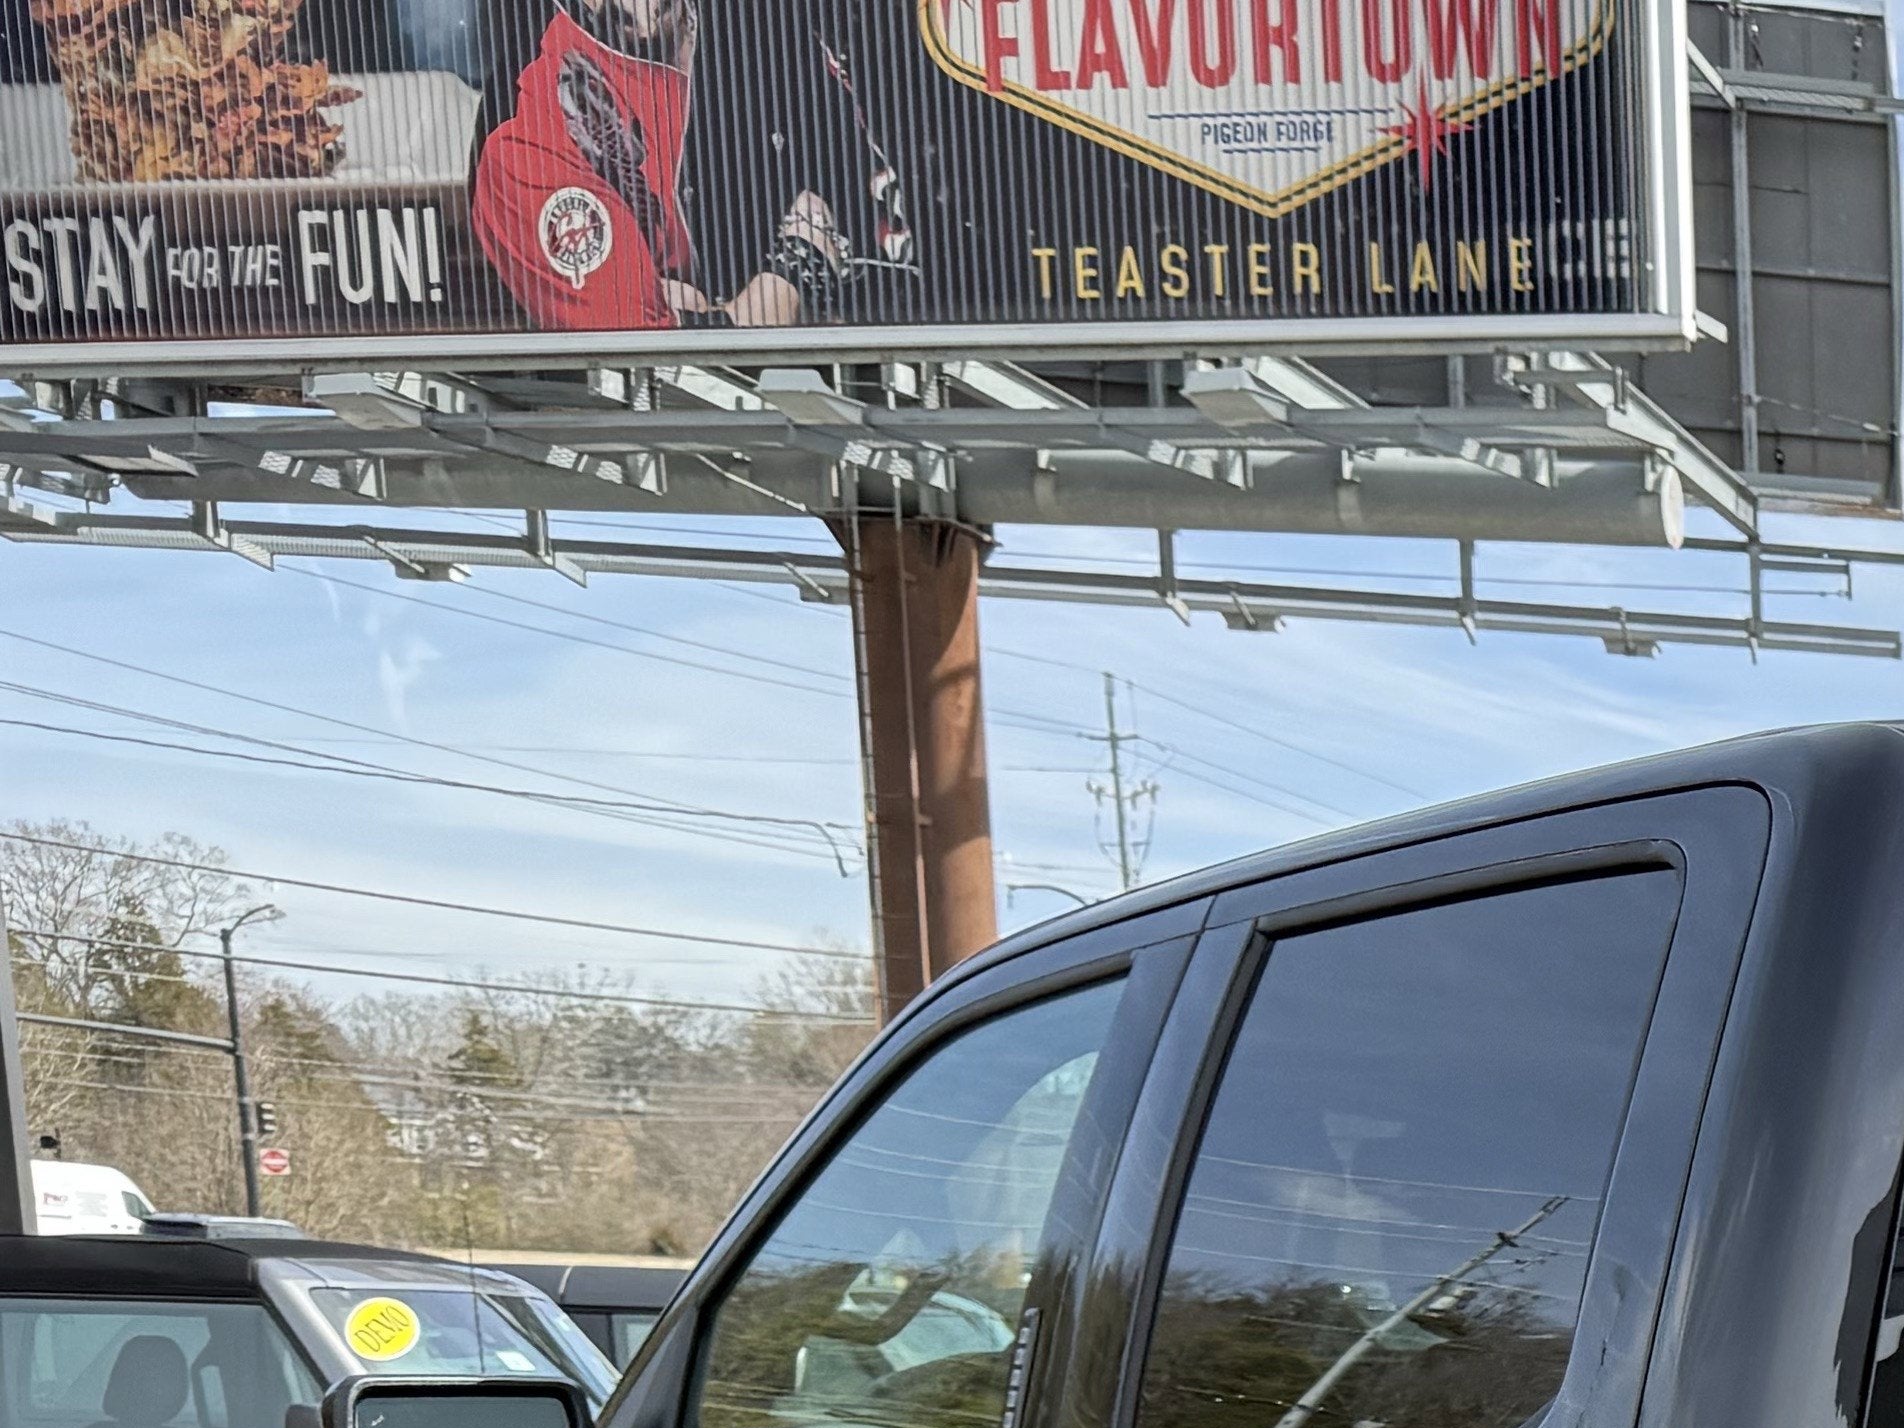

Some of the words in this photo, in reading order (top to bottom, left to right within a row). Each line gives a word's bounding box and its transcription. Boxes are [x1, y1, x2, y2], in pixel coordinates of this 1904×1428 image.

[1200, 121, 1270, 147] PIGEON
[1275, 120, 1336, 145] FORGE
[4, 213, 156, 313] STAY
[166, 246, 219, 289] FOR
[228, 243, 281, 288] THE
[297, 206, 443, 306] FUN!
[1032, 242, 1322, 300] TEASTER
[1370, 237, 1535, 295] LANE
